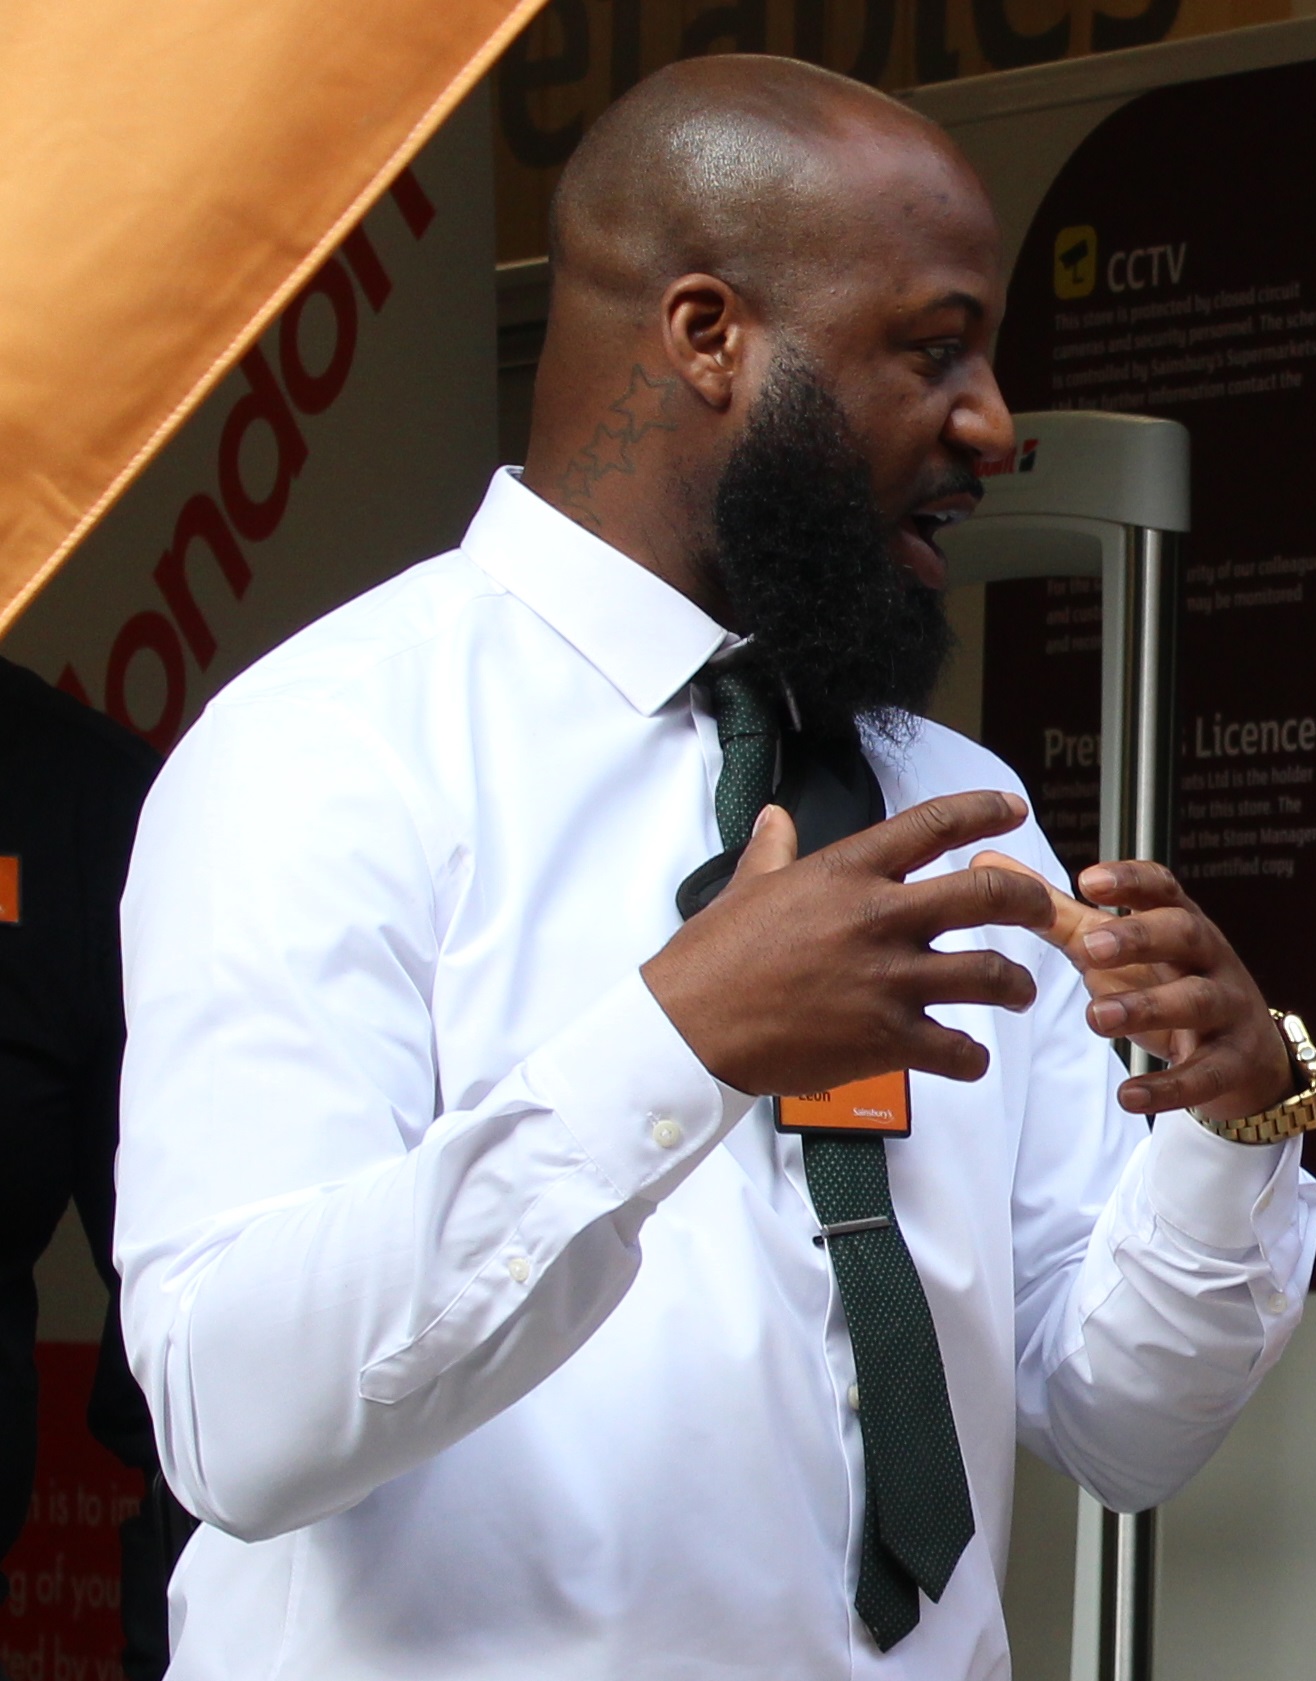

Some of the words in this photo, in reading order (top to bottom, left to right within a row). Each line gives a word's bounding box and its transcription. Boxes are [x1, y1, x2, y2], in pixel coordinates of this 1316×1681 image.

[1107, 242, 1187, 293] CCTV
[1055, 313, 1080, 331] This
[1083, 310, 1116, 329] store
[1117, 306, 1128, 326] is
[1130, 296, 1192, 325] protected
[1194, 294, 1212, 315] by
[1214, 286, 1256, 309] closed
[1257, 281, 1300, 304] circuit
[1053, 340, 1105, 361] cameras
[1107, 333, 1132, 353] and
[1134, 327, 1187, 350] security
[1260, 313, 1283, 331] The
[1052, 371, 1063, 390] is
[1065, 362, 1130, 387] controlled
[1132, 361, 1149, 383] by
[1151, 351, 1224, 376] Sainsbury's
[1148, 382, 1225, 406] information
[1227, 374, 1277, 397] contact
[1280, 370, 1303, 388] the
[54, 167, 436, 757] ondon
[1217, 558, 1232, 579] of
[1234, 562, 1256, 578] our
[1215, 590, 1231, 609] be
[1234, 582, 1304, 607] monitored
[1046, 605, 1070, 626] and
[1044, 728, 1100, 770] Pre
[1208, 768, 1230, 790] Ltd
[1232, 768, 1244, 787] is
[1246, 766, 1269, 787] the
[1271, 763, 1315, 785] holder
[1188, 800, 1207, 820] for
[1209, 797, 1236, 819] this
[1277, 793, 1303, 814] The
[1198, 828, 1221, 849] the
[1223, 826, 1258, 848] Store
[1202, 855, 1260, 878] certified
[1261, 857, 1295, 879] copy
[853, 1106, 894, 1120] Sainsbury's
[48, 1478, 69, 1527] is
[77, 1483, 102, 1527] to
[35, 1551, 67, 1605] of
